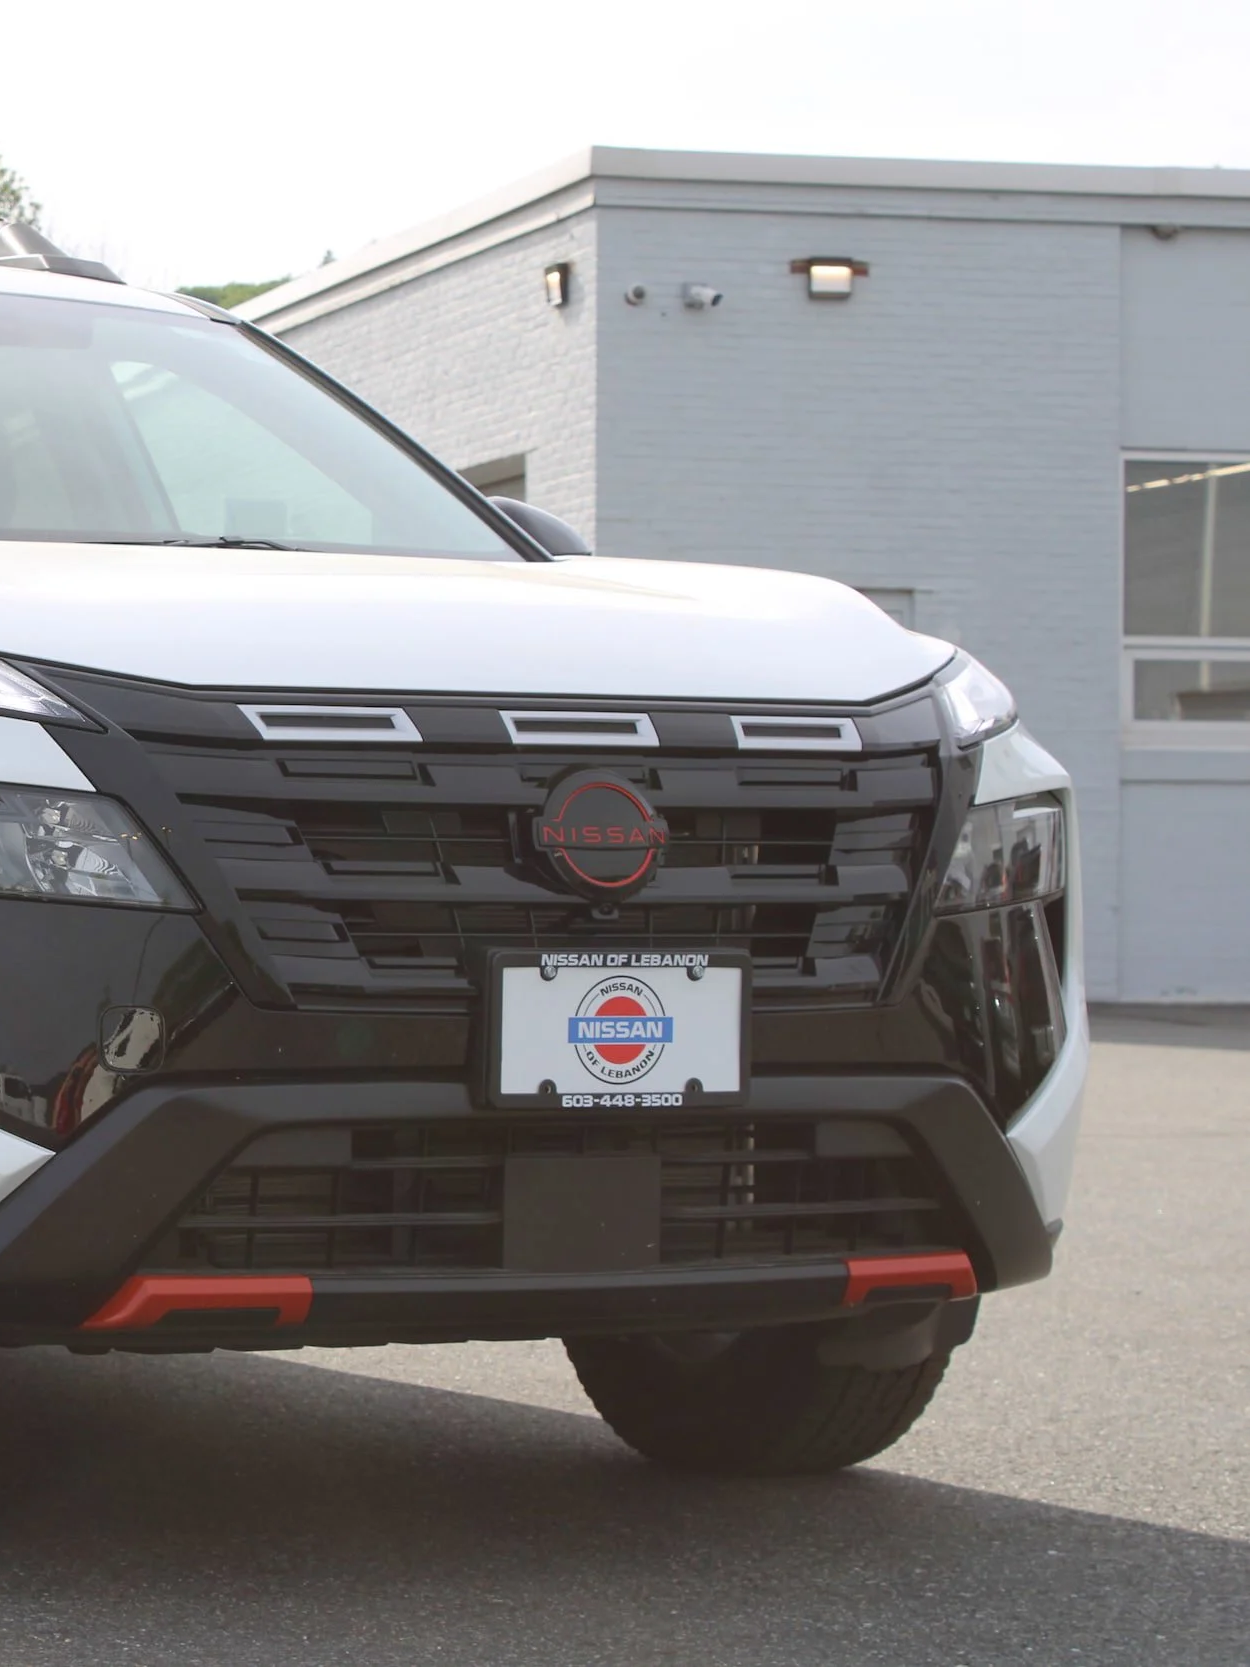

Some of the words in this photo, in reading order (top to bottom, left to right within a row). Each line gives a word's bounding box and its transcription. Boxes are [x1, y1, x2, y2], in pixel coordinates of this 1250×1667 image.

[542, 826, 666, 844] NISSAN
[540, 953, 603, 967] NISSAN
[606, 954, 627, 967] OF
[630, 954, 709, 967] LEBANON
[599, 982, 644, 997] NISSAN
[577, 1021, 663, 1039] NISSAN
[585, 1050, 600, 1073] OF
[600, 1049, 656, 1079] LEBANON
[561, 1093, 683, 1108] 603-448-3500
